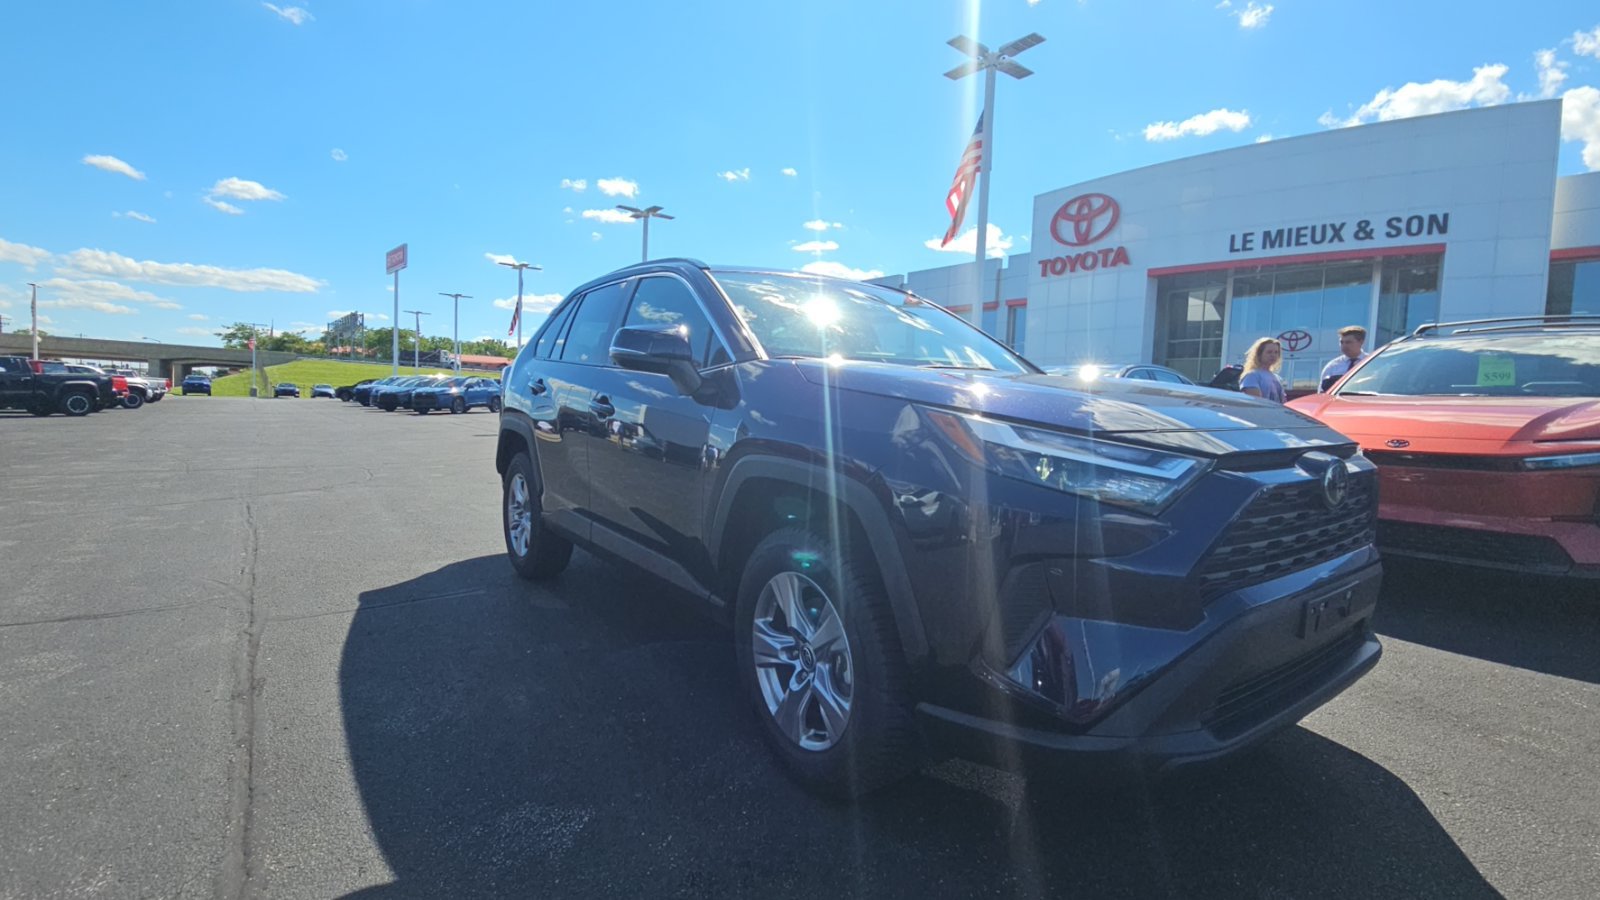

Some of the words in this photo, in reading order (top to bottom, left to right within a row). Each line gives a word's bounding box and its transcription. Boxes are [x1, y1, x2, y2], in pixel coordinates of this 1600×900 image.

[1229, 232, 1255, 253] LE
[1261, 222, 1346, 250] MIEUX
[1353, 219, 1375, 241] &
[1385, 212, 1449, 238] SON
[1038, 246, 1130, 277] TOYOTA
